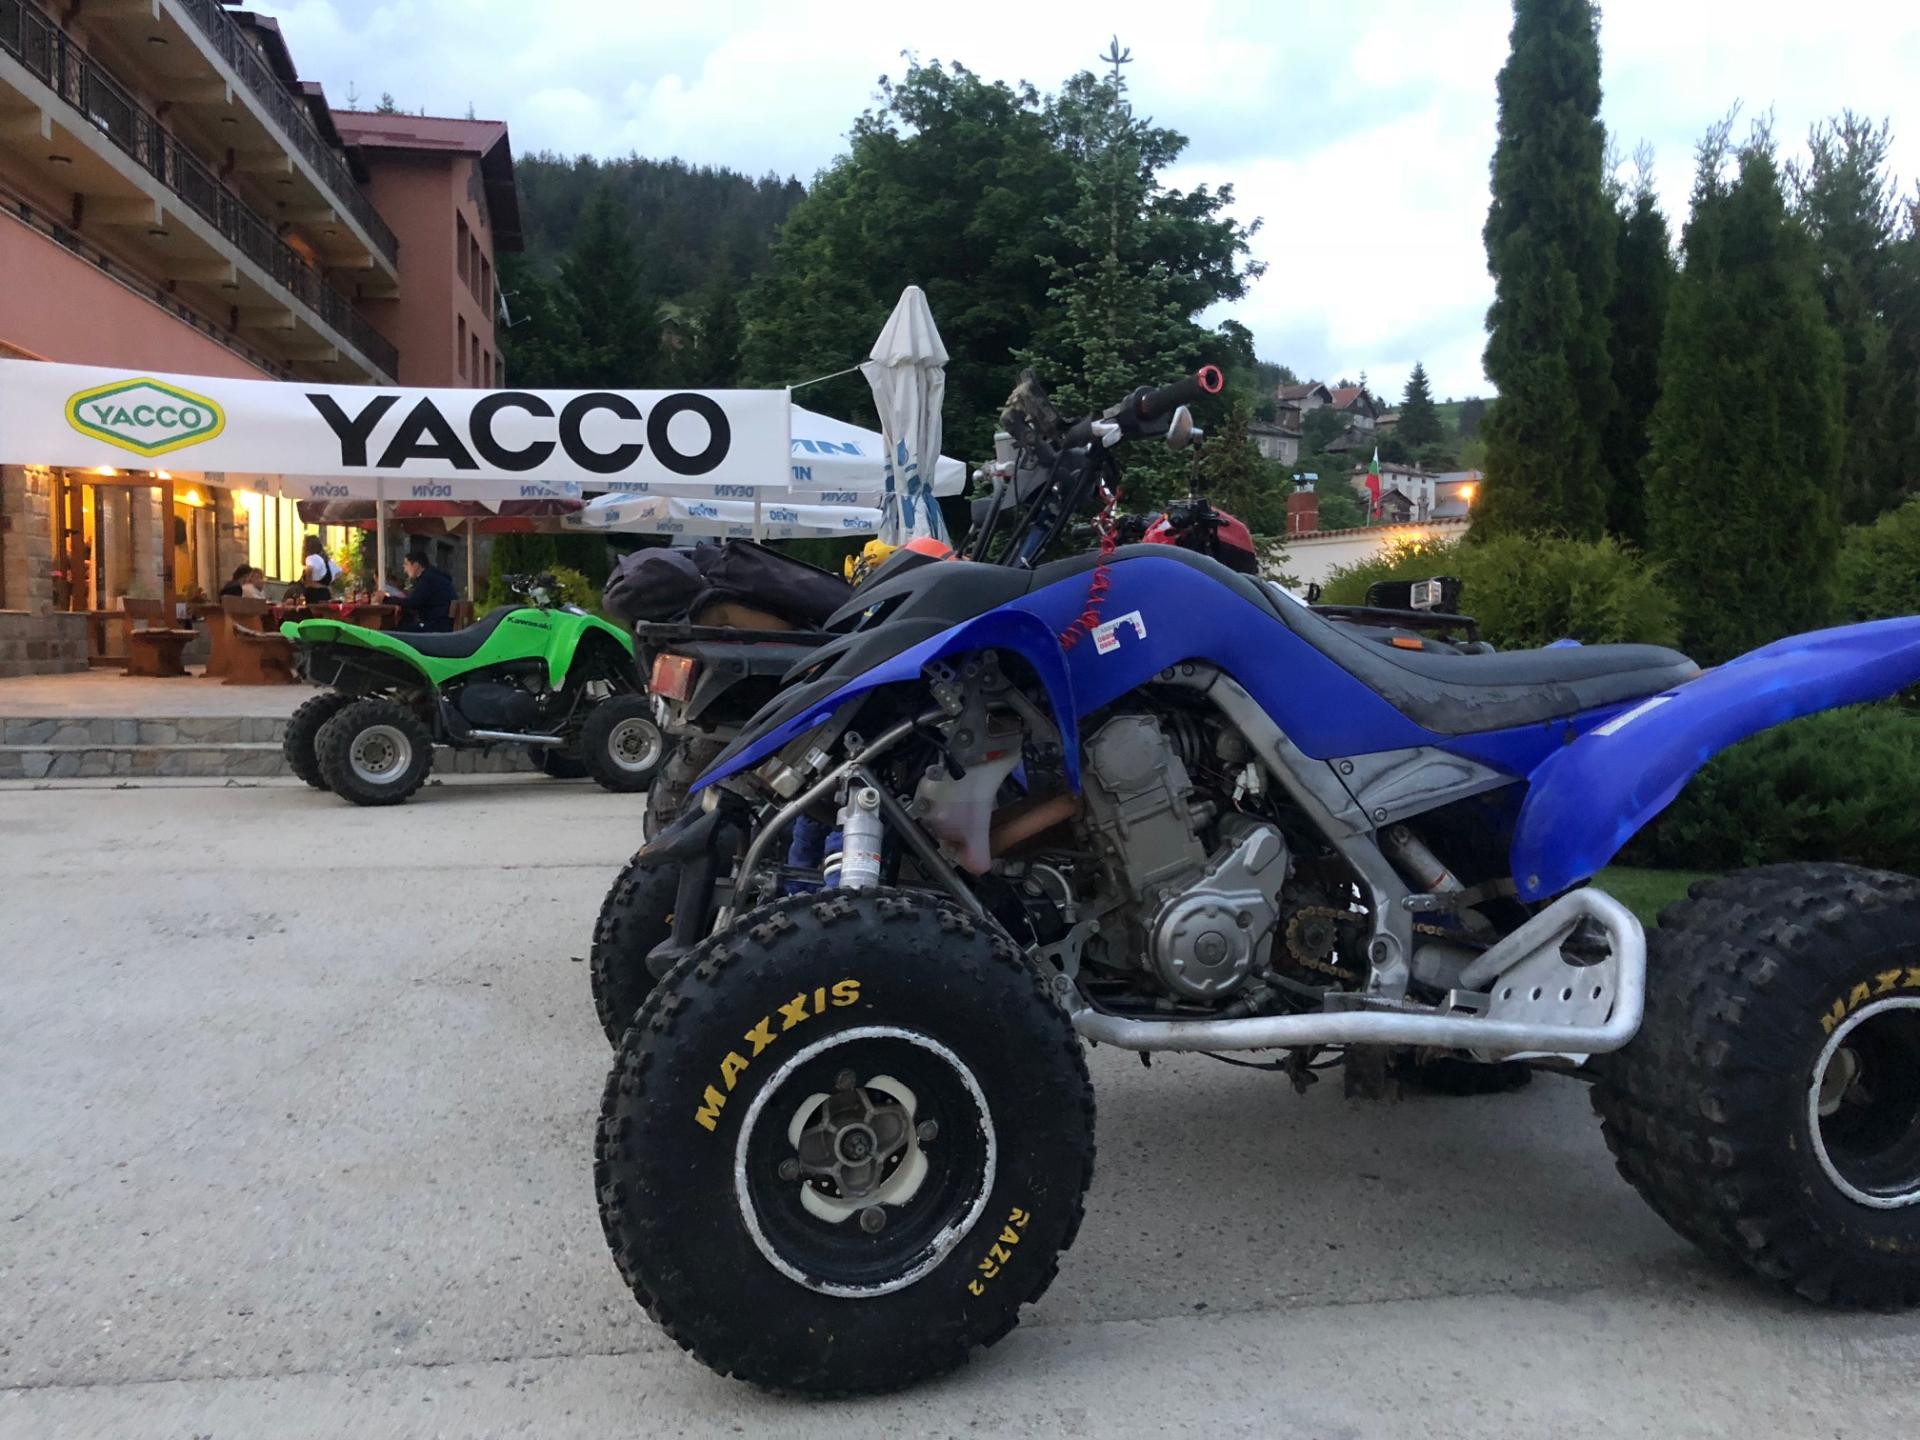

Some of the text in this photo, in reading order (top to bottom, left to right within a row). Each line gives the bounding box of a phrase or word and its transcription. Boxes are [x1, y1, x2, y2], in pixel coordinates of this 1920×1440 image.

[91, 404, 202, 429] YACCO
[305, 391, 731, 476] YACCO
[695, 979, 861, 1132] MAXXIS
[967, 1207, 1030, 1296] RAZR 2
